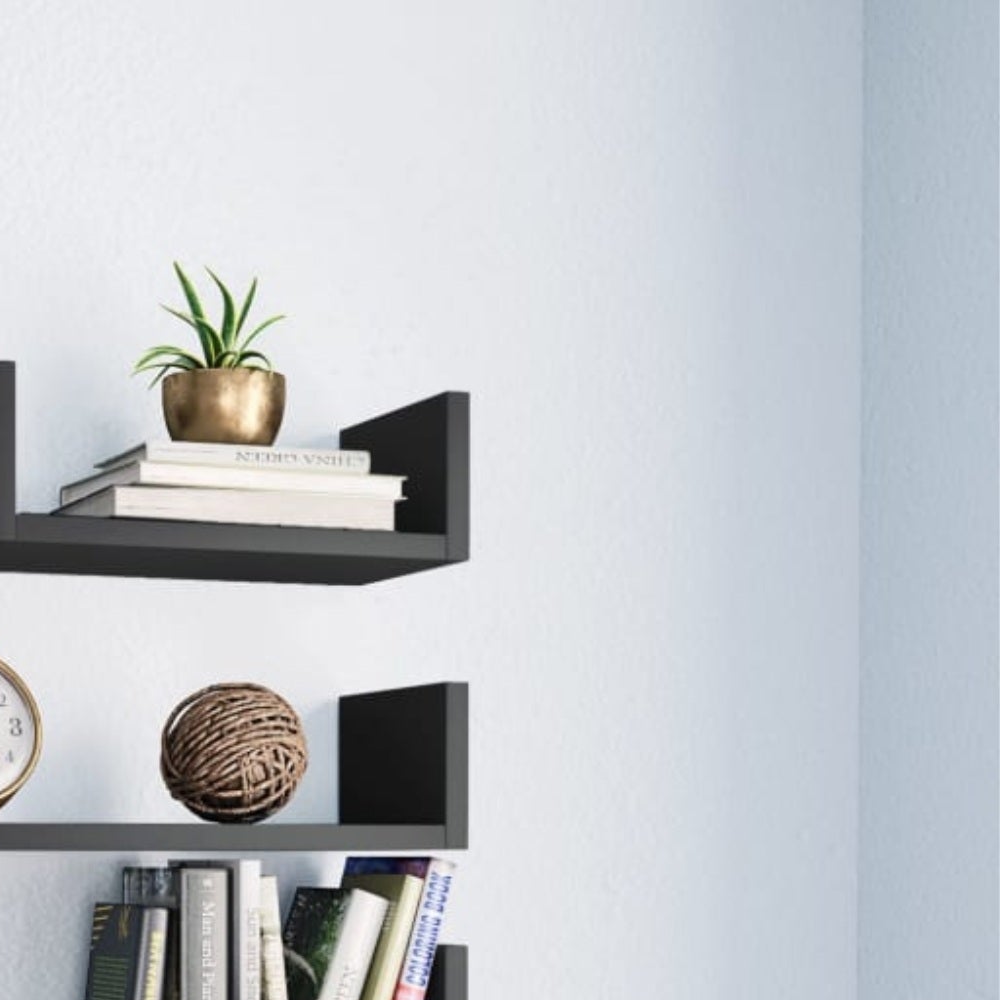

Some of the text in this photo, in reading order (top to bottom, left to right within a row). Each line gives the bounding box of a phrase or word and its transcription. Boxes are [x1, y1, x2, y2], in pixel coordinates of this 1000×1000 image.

[8, 717, 23, 737] 3
[4, 749, 14, 763] 4
[201, 900, 217, 936] Man
[405, 914, 442, 988] COLORING
[424, 870, 453, 914] BOOK
[201, 939, 217, 968] and
